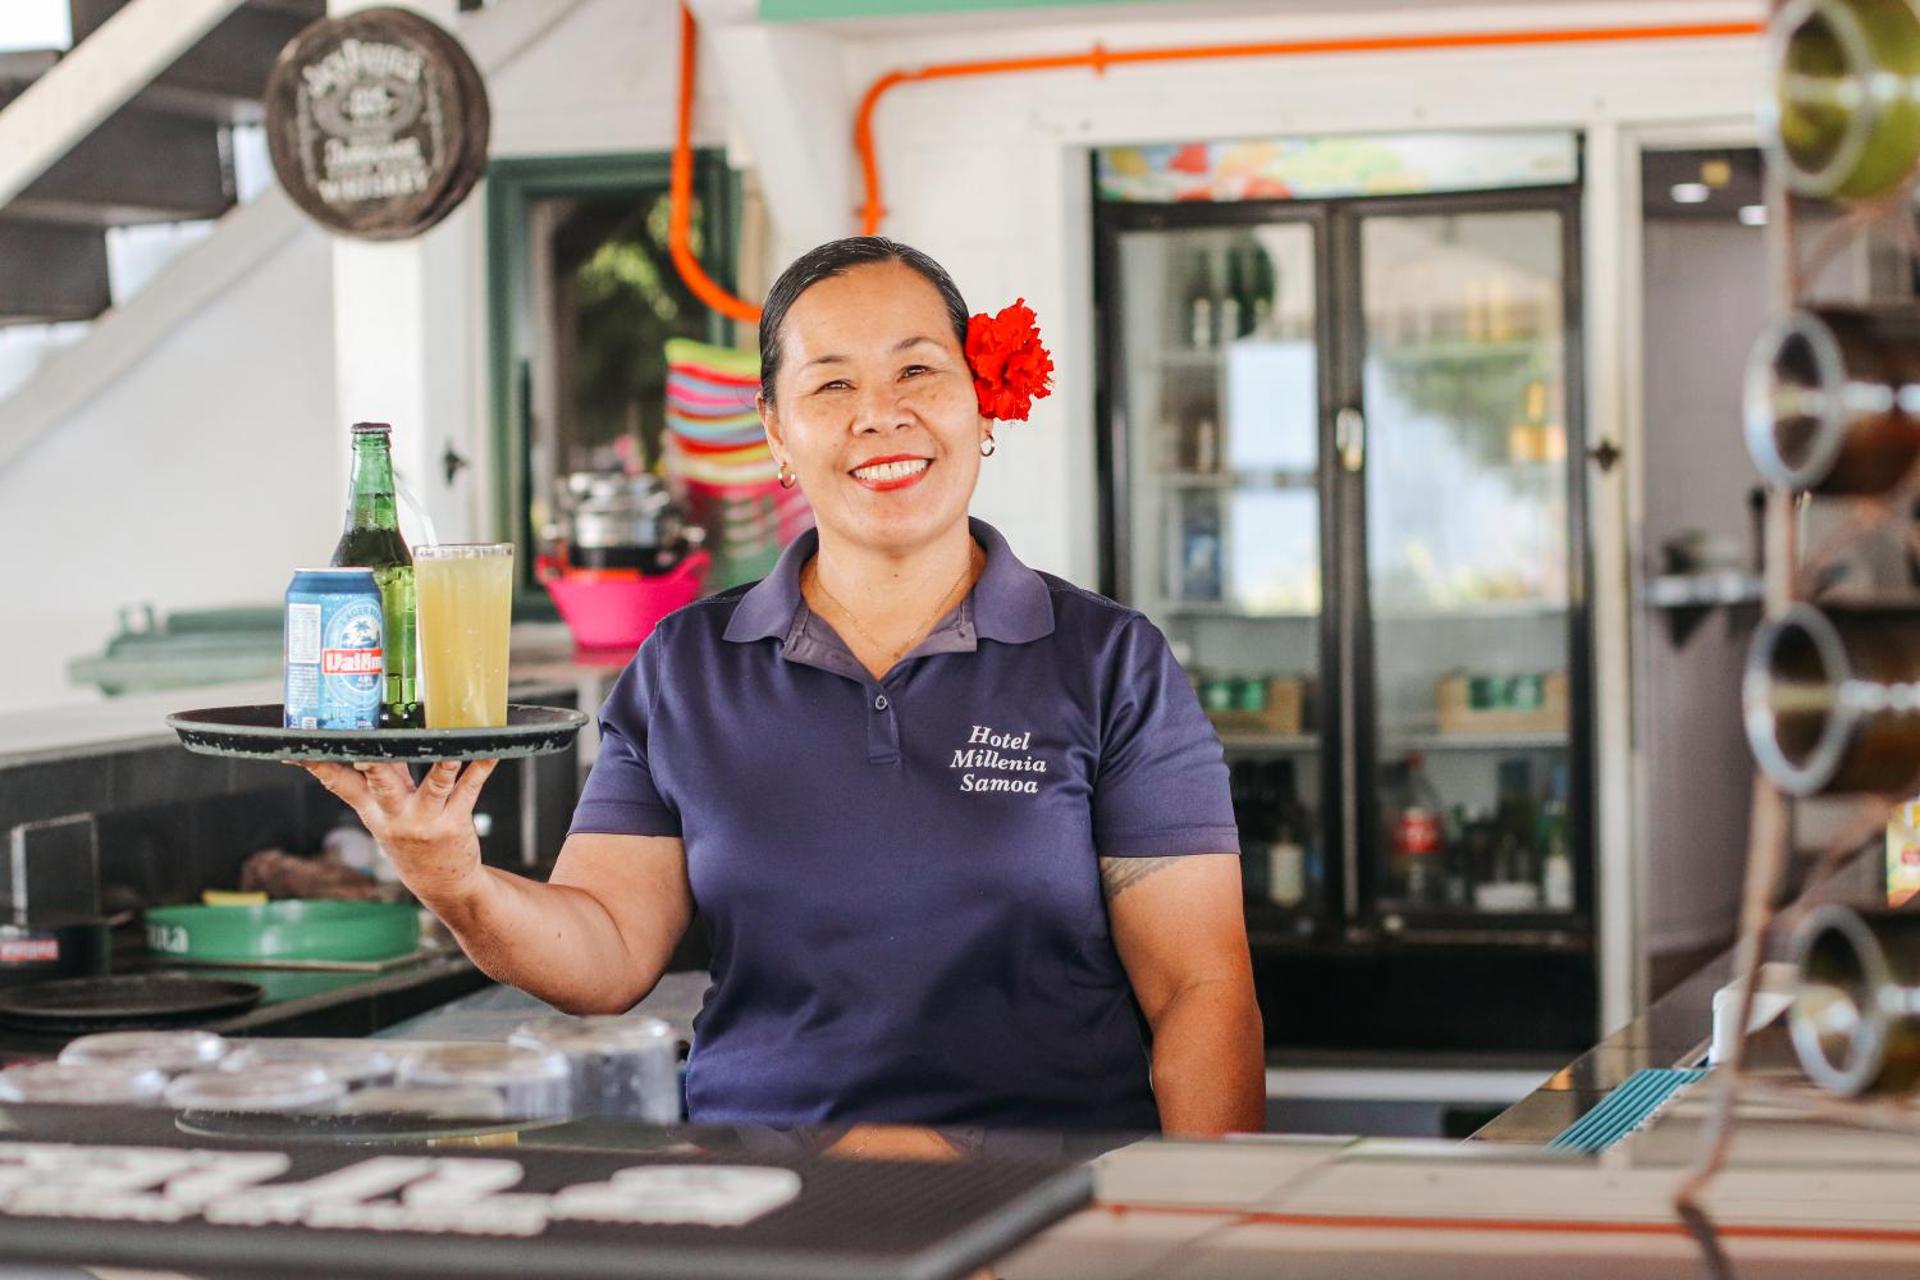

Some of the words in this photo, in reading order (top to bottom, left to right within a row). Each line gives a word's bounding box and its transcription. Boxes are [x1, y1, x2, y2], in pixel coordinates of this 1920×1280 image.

[967, 725, 1031, 750] Hotel
[949, 749, 1047, 773] Millenia
[960, 773, 1039, 794] Samoa
